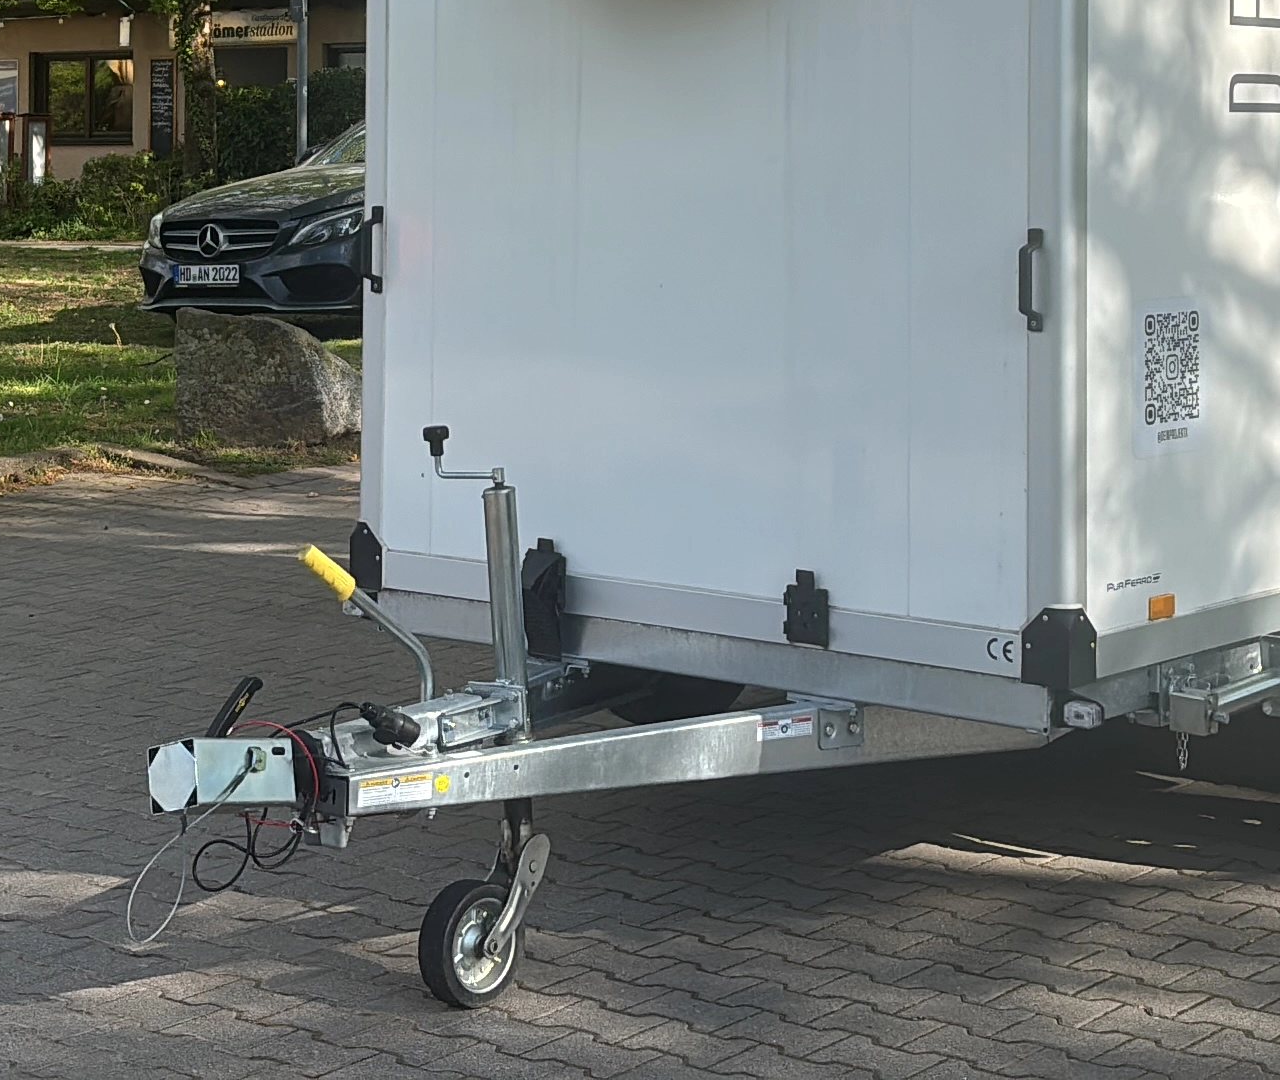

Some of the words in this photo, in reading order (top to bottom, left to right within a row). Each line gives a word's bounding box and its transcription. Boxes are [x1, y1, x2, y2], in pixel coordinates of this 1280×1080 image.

[214, 21, 293, 38] ömerstadion
[180, 267, 192, 281] HD
[198, 267, 210, 281] AN
[212, 267, 238, 281] 2022
[986, 637, 1014, 663] CE
